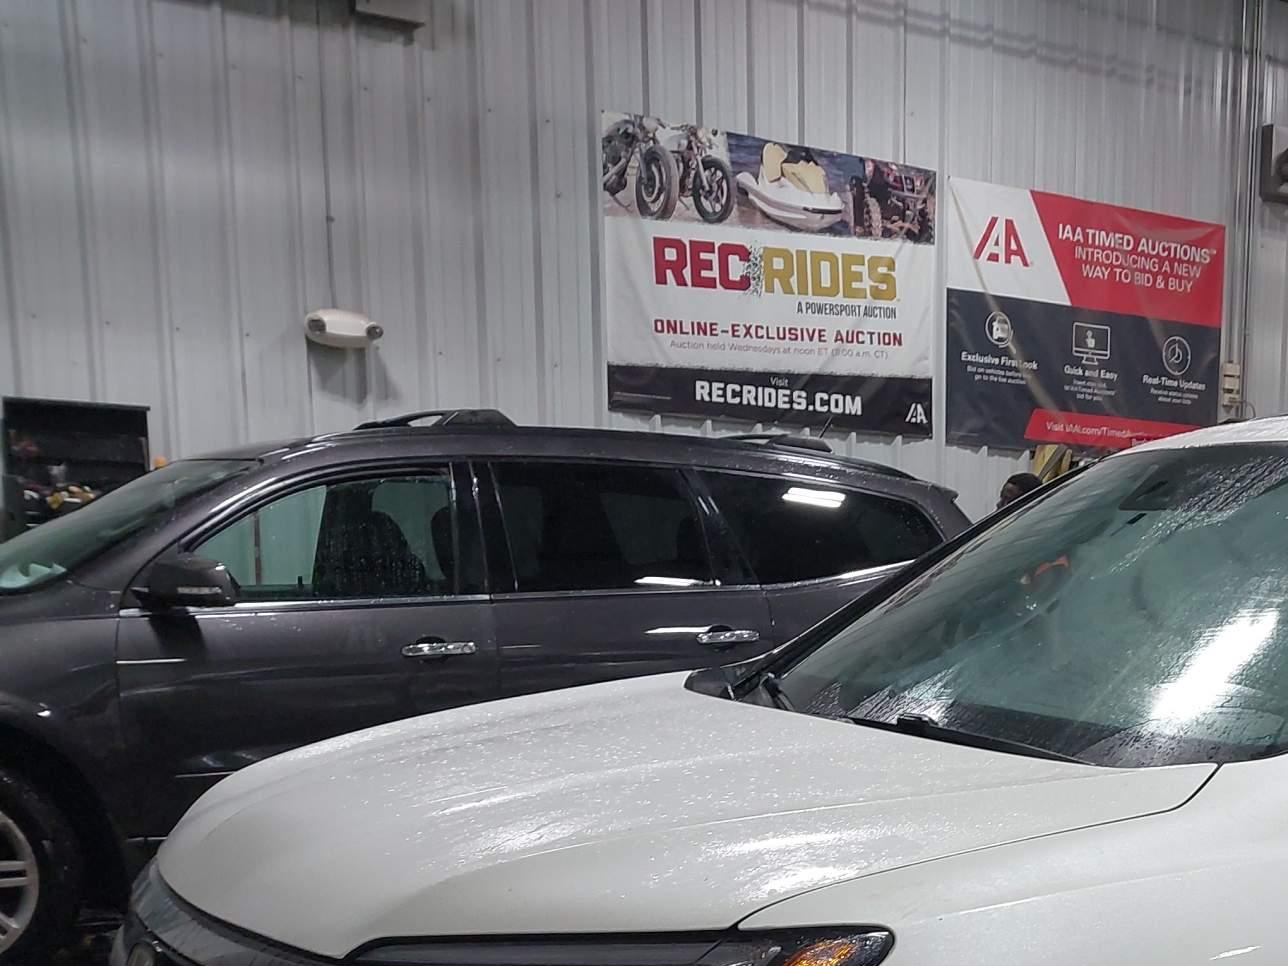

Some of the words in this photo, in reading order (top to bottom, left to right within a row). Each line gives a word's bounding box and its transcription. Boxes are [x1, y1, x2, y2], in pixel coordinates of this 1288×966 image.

[1058, 223, 1084, 243] IAA
[1086, 229, 1134, 251] TIMED
[653, 236, 751, 292] REC
[763, 246, 897, 301] RIDES
[1075, 246, 1159, 272] INTRODUCING
[1162, 261, 1171, 275] A
[1173, 263, 1202, 279] NEW
[1082, 263, 1111, 279] WAY
[1113, 268, 1131, 283] TO
[1135, 272, 1153, 287] BID
[1155, 276, 1165, 289] &
[1168, 277, 1194, 293] BUY
[797, 301, 804, 314] A
[805, 302, 863, 318] POWERSPORT
[863, 305, 896, 320] AUCTION
[654, 318, 828, 343] ONLINE-EXCLUSIVE
[834, 328, 903, 347] AUCTION
[670, 340, 704, 350] Auction
[706, 341, 726, 351] held
[727, 342, 780, 355] Wednesdays
[782, 346, 791, 354] at
[793, 347, 815, 356] noon
[961, 351, 1000, 365] Exclusive
[769, 376, 789, 388] Visit
[1064, 364, 1083, 376] Quick
[1085, 367, 1098, 378] and
[1100, 369, 1118, 382] Easy
[1142, 374, 1178, 388] Real-Time
[1179, 378, 1206, 392] Updates
[695, 380, 863, 416] RECRIDES.COM
